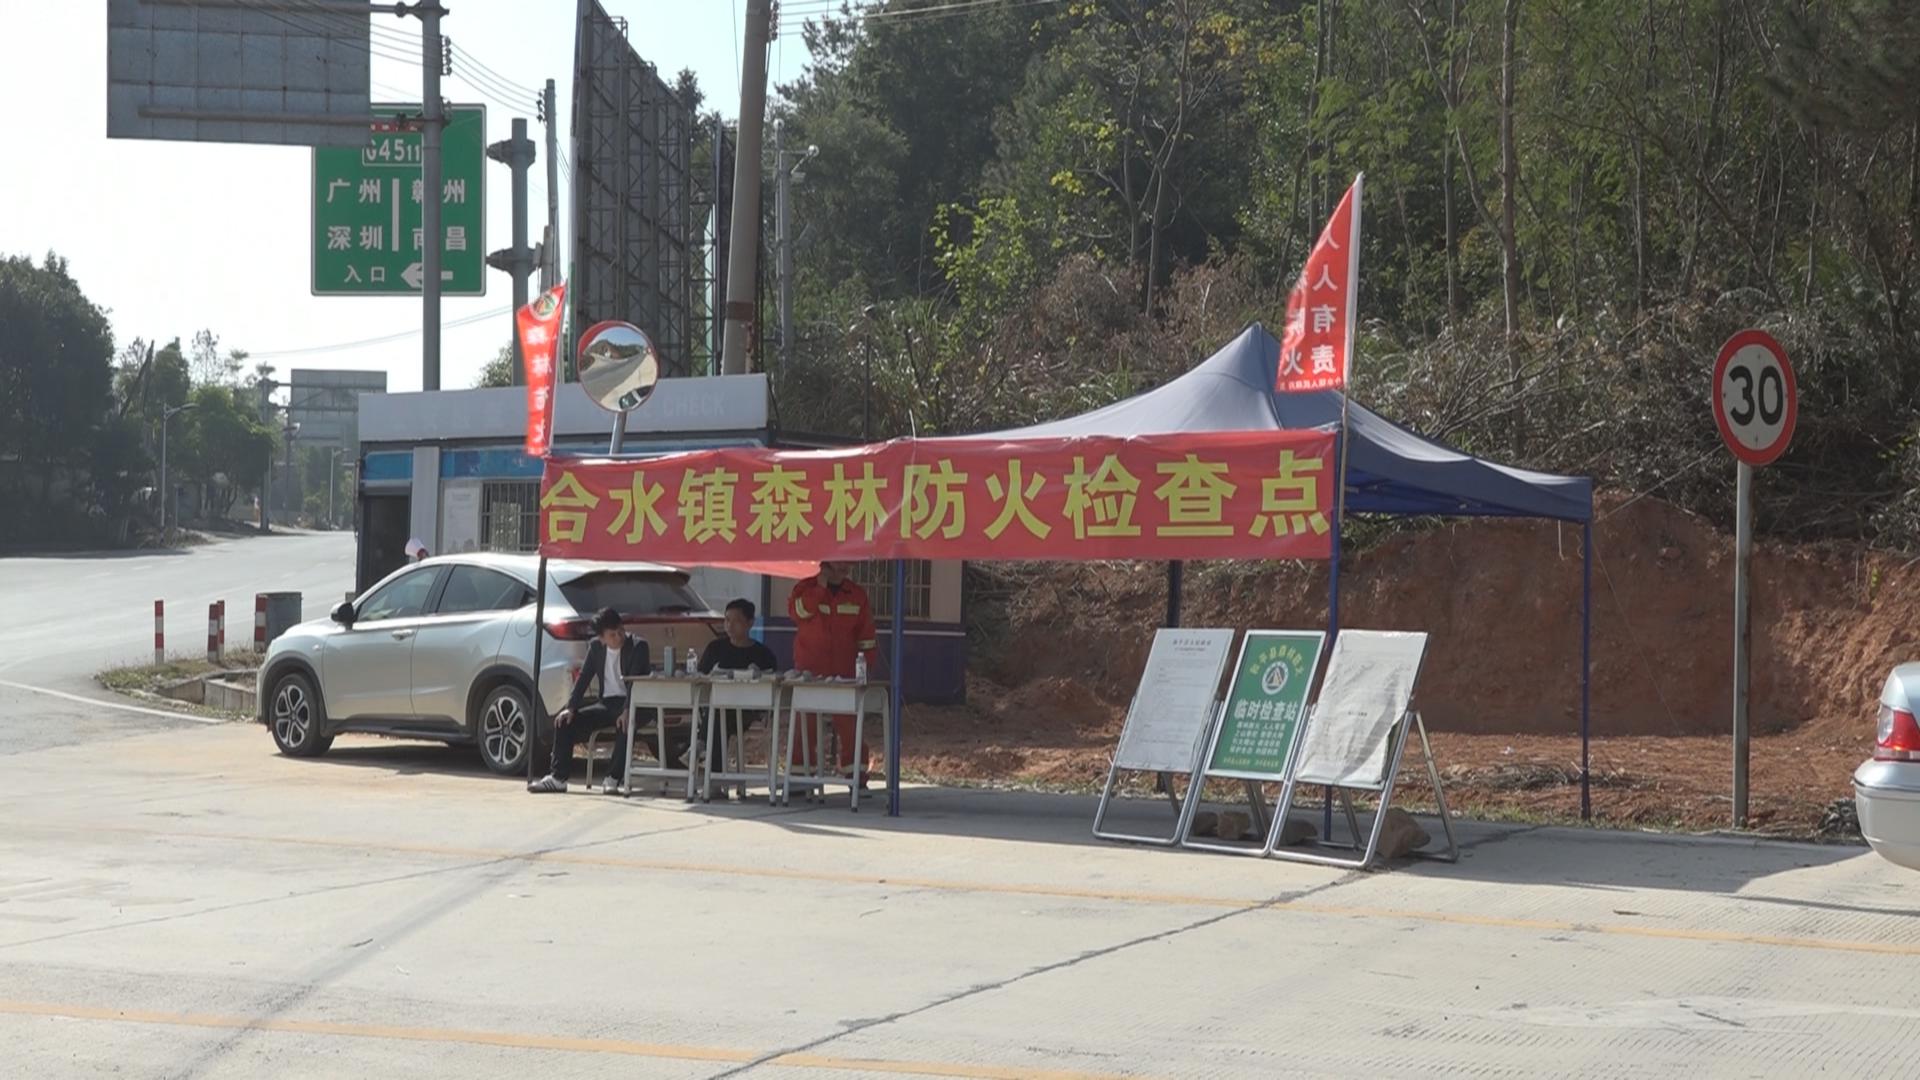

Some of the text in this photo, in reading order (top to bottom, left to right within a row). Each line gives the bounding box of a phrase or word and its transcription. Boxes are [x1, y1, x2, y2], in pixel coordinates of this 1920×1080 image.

[327, 178, 381, 203] 广州
[327, 225, 383, 250] 深圳
[344, 265, 385, 283] 入口
[1729, 365, 1783, 426] 30
[540, 449, 1330, 545] 合水镇森林防火检查点
[1234, 698, 1298, 721] 临时检查站
